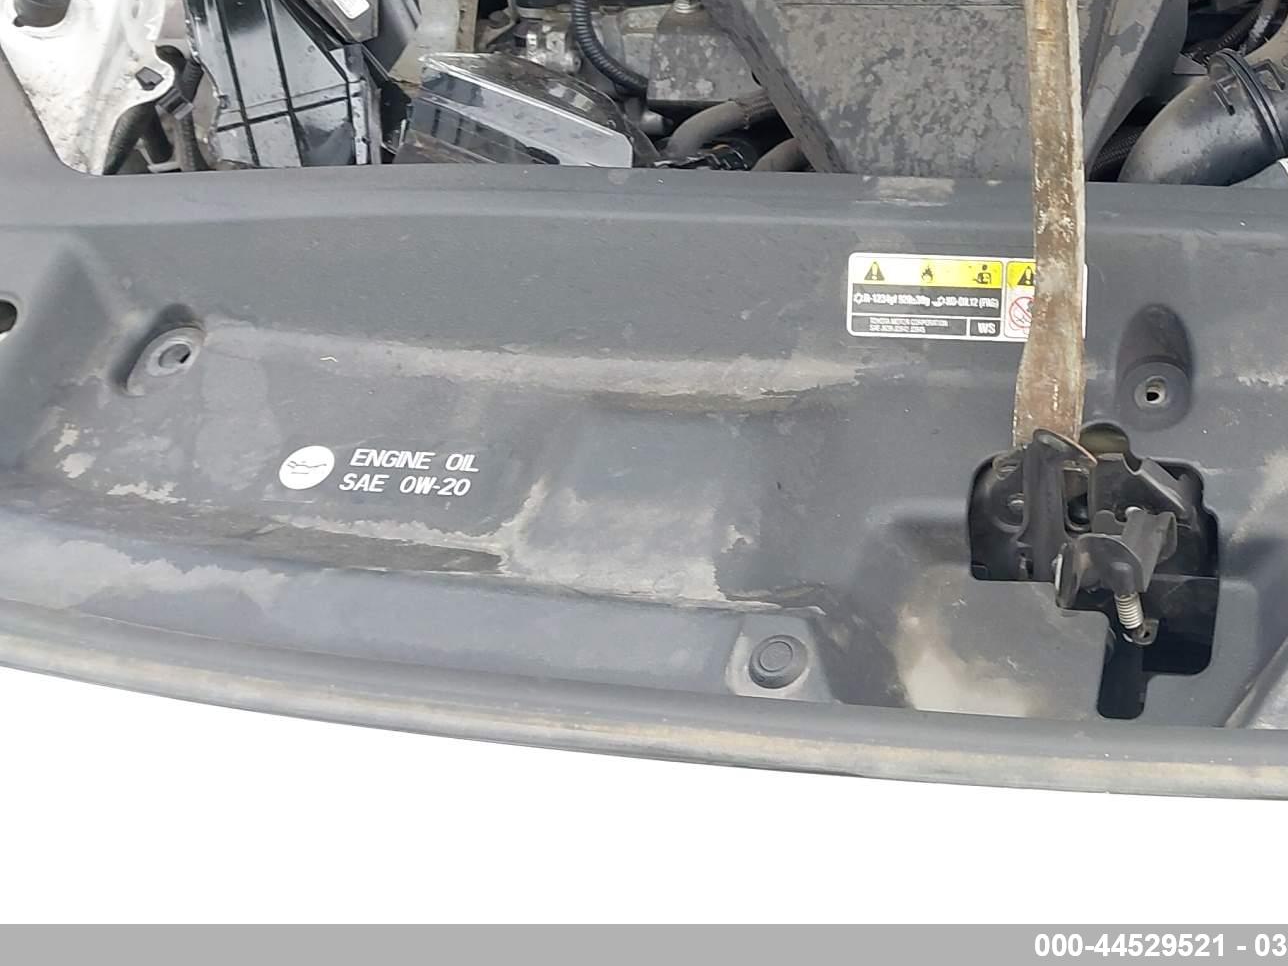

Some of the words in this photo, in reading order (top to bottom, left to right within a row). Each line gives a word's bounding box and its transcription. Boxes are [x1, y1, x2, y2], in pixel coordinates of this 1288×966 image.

[977, 321, 996, 334] WS
[350, 448, 436, 470] ENGINE
[445, 453, 479, 473] OIL
[339, 472, 389, 493] SAE
[399, 475, 471, 497] 0W-20
